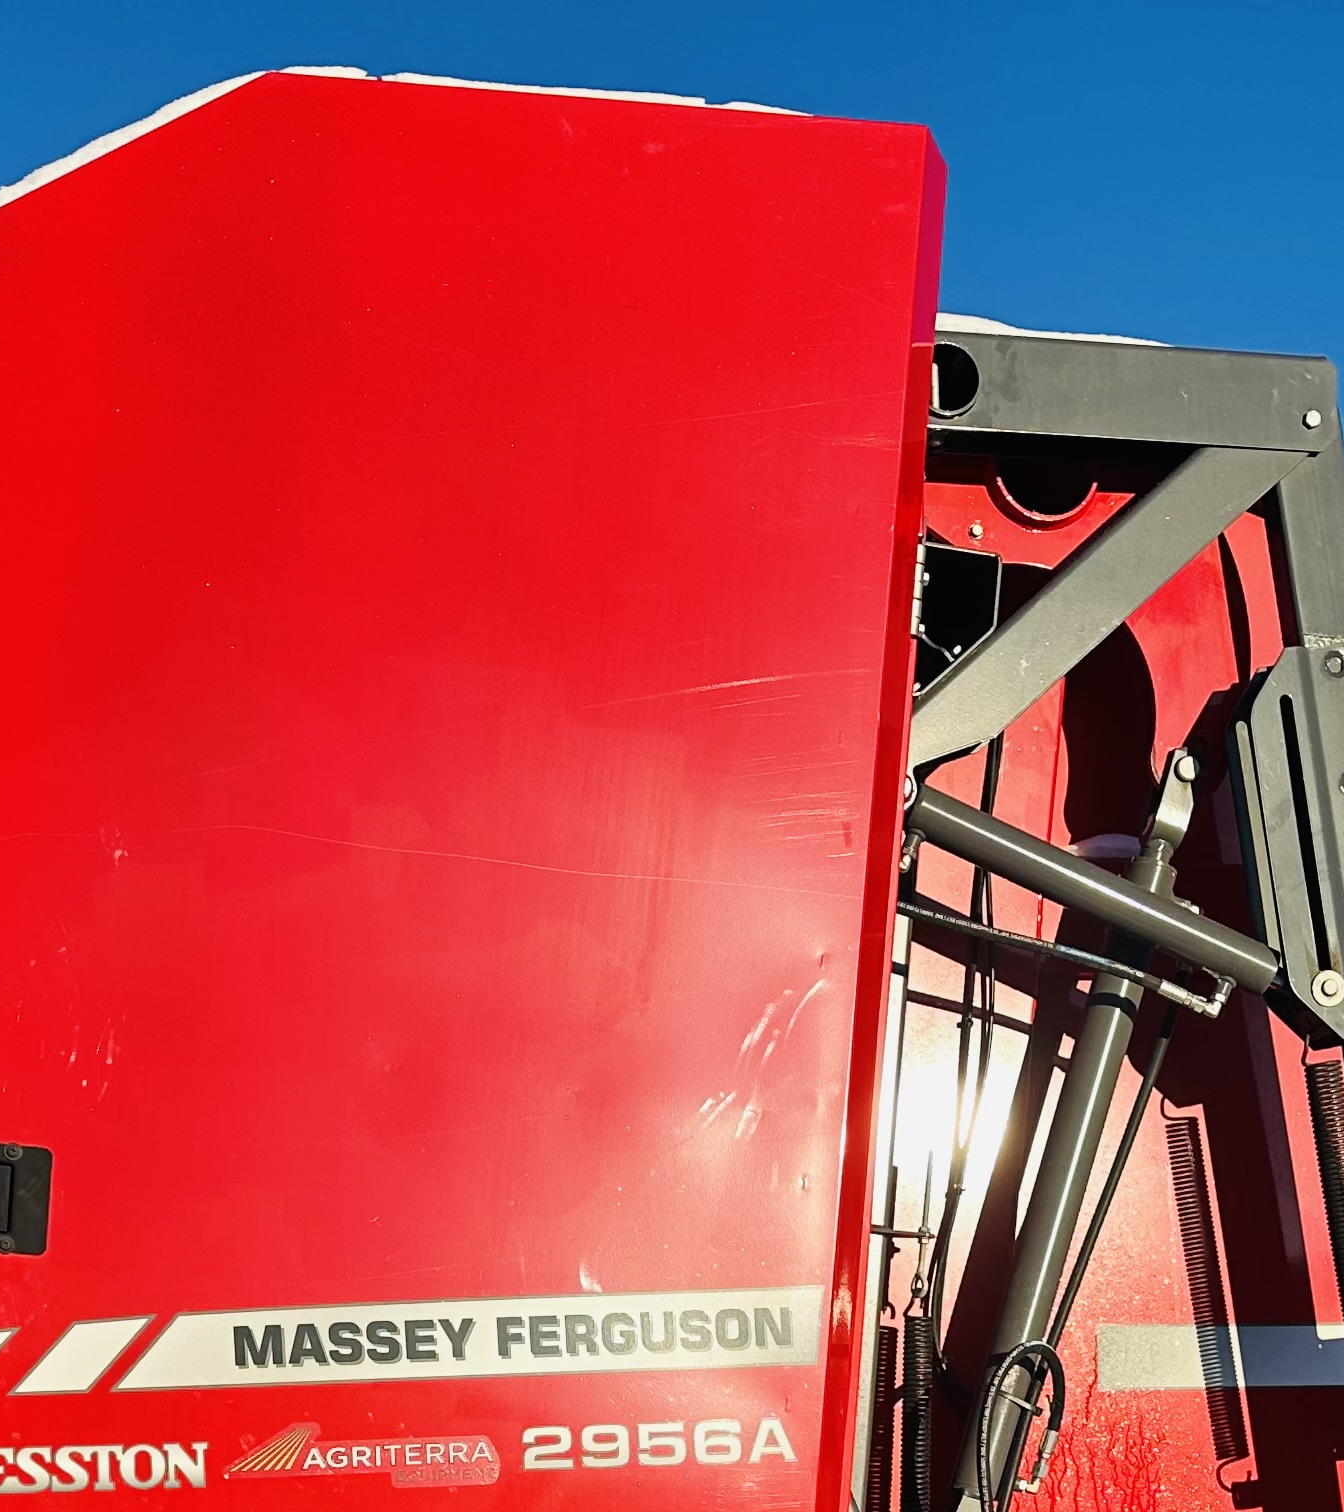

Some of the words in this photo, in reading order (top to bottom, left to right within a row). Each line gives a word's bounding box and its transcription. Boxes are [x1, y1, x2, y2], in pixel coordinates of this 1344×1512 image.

[232, 1317, 477, 1370] MASSEY
[496, 1306, 794, 1359] FERGUSON
[302, 1440, 494, 1471] AGRITERRA
[521, 1416, 799, 1471] 2956A
